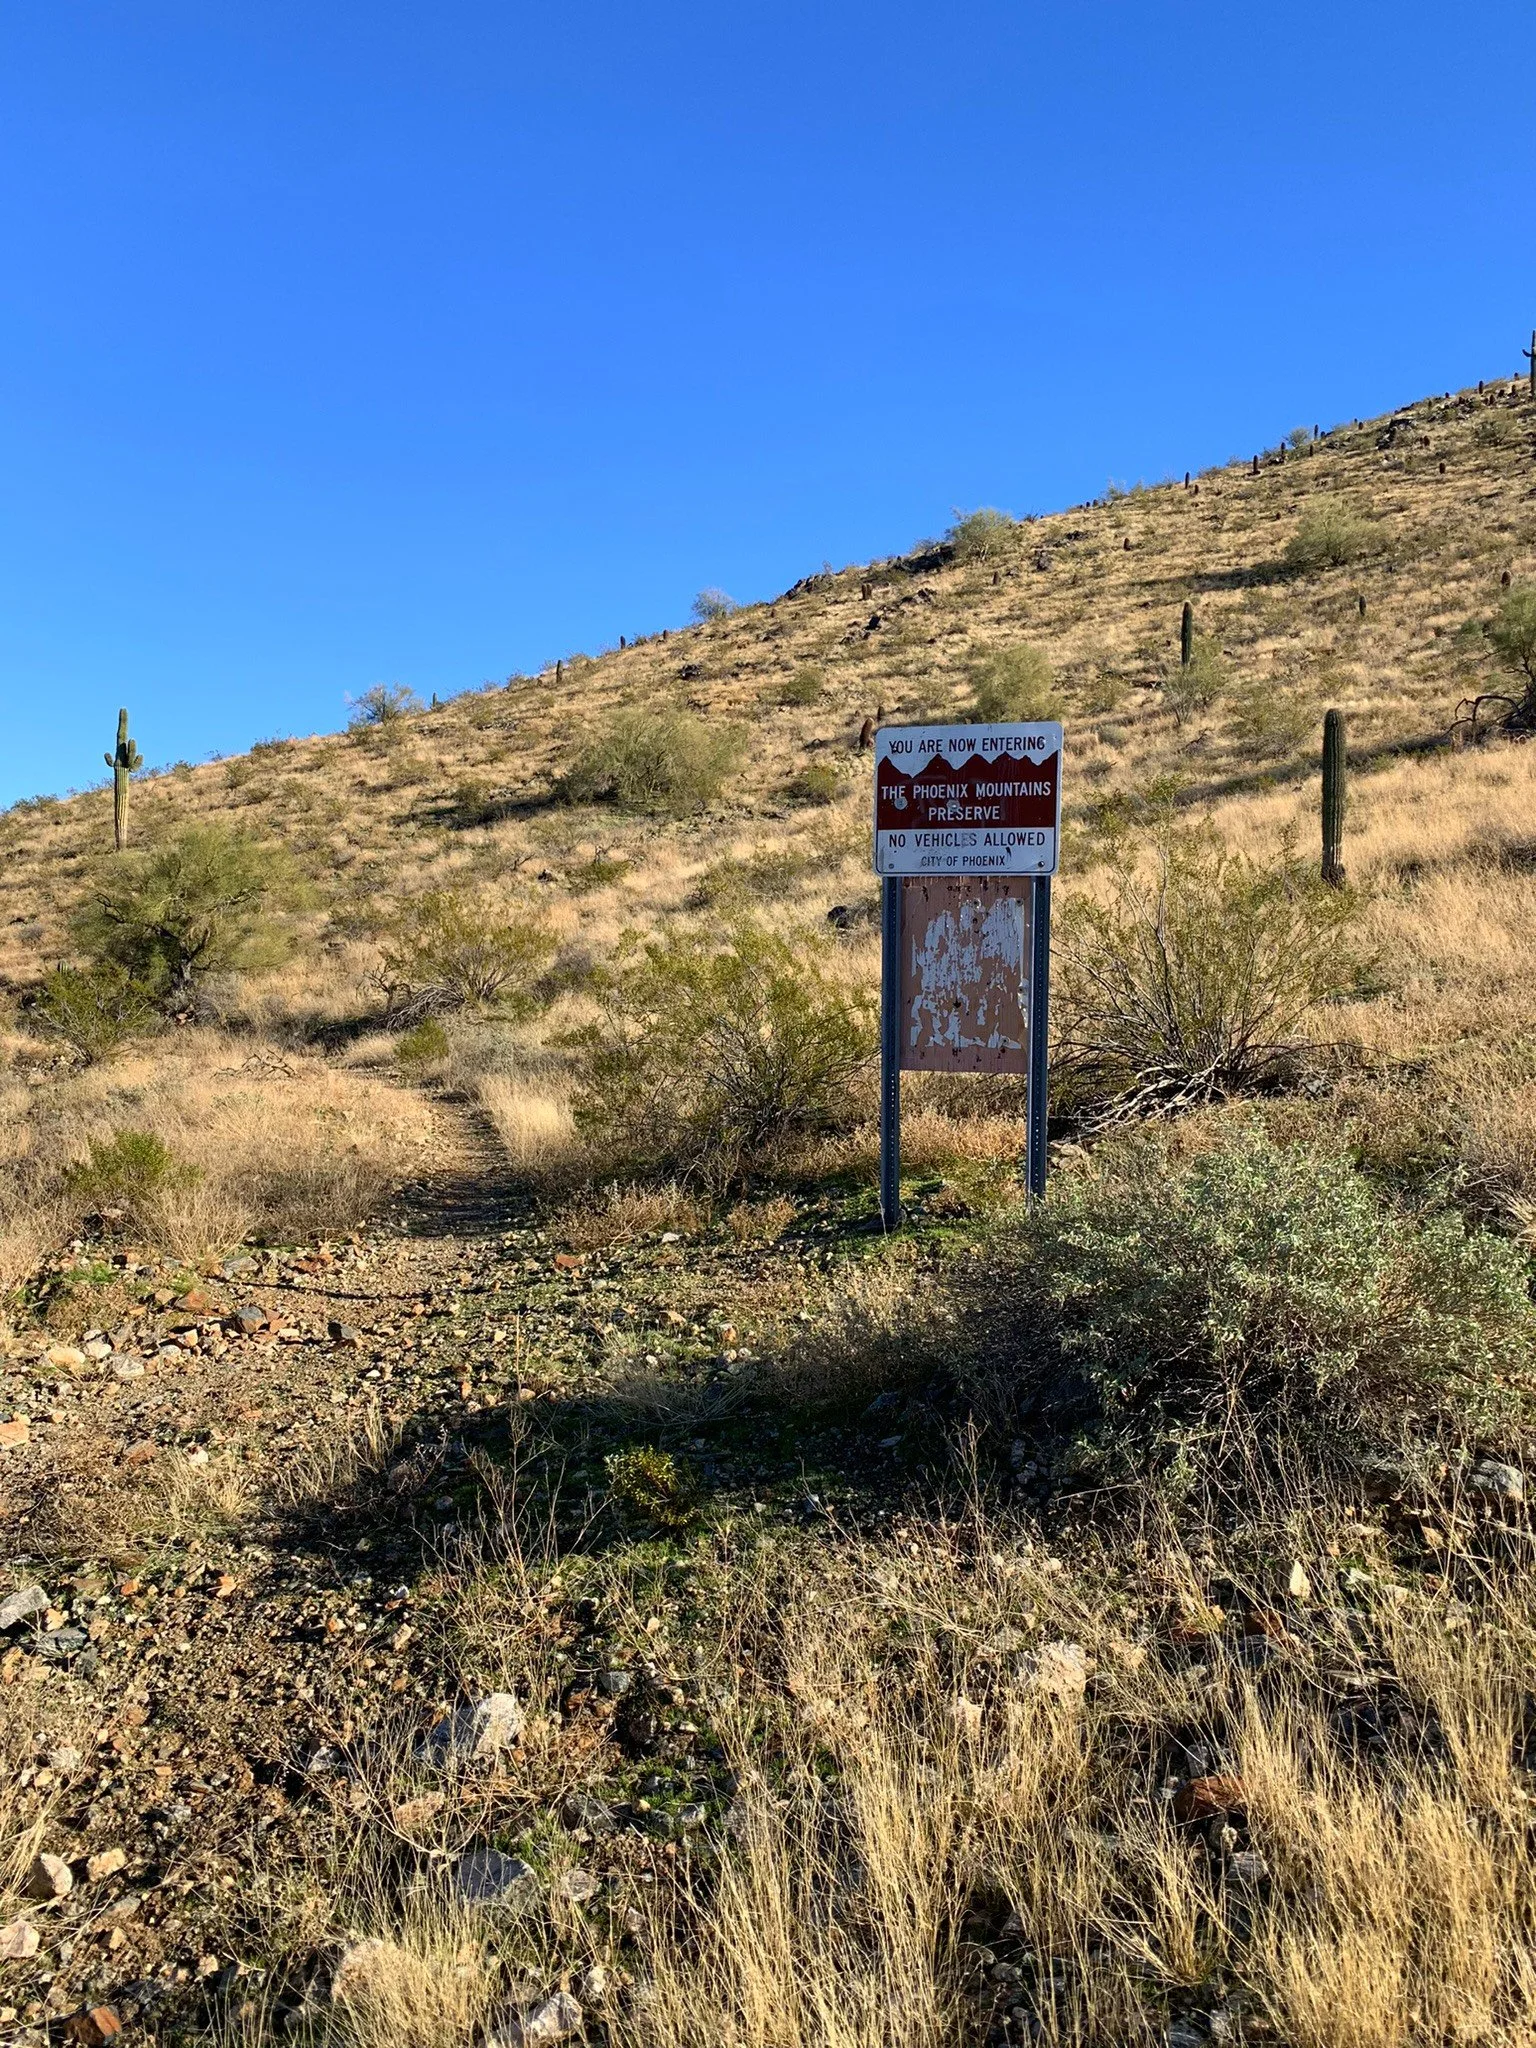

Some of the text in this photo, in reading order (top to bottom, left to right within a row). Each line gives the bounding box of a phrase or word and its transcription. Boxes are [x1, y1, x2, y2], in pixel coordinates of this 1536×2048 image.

[889, 736, 1045, 753] YOU ARE NOW ENTERING
[882, 782, 1051, 799] THE PHOENIX MOUNTAINS
[929, 806, 1000, 821] PRESERVE
[889, 832, 1045, 847] NO VEHICLES ALLOWED
[922, 855, 1005, 866] CITY OF PHOENIX
